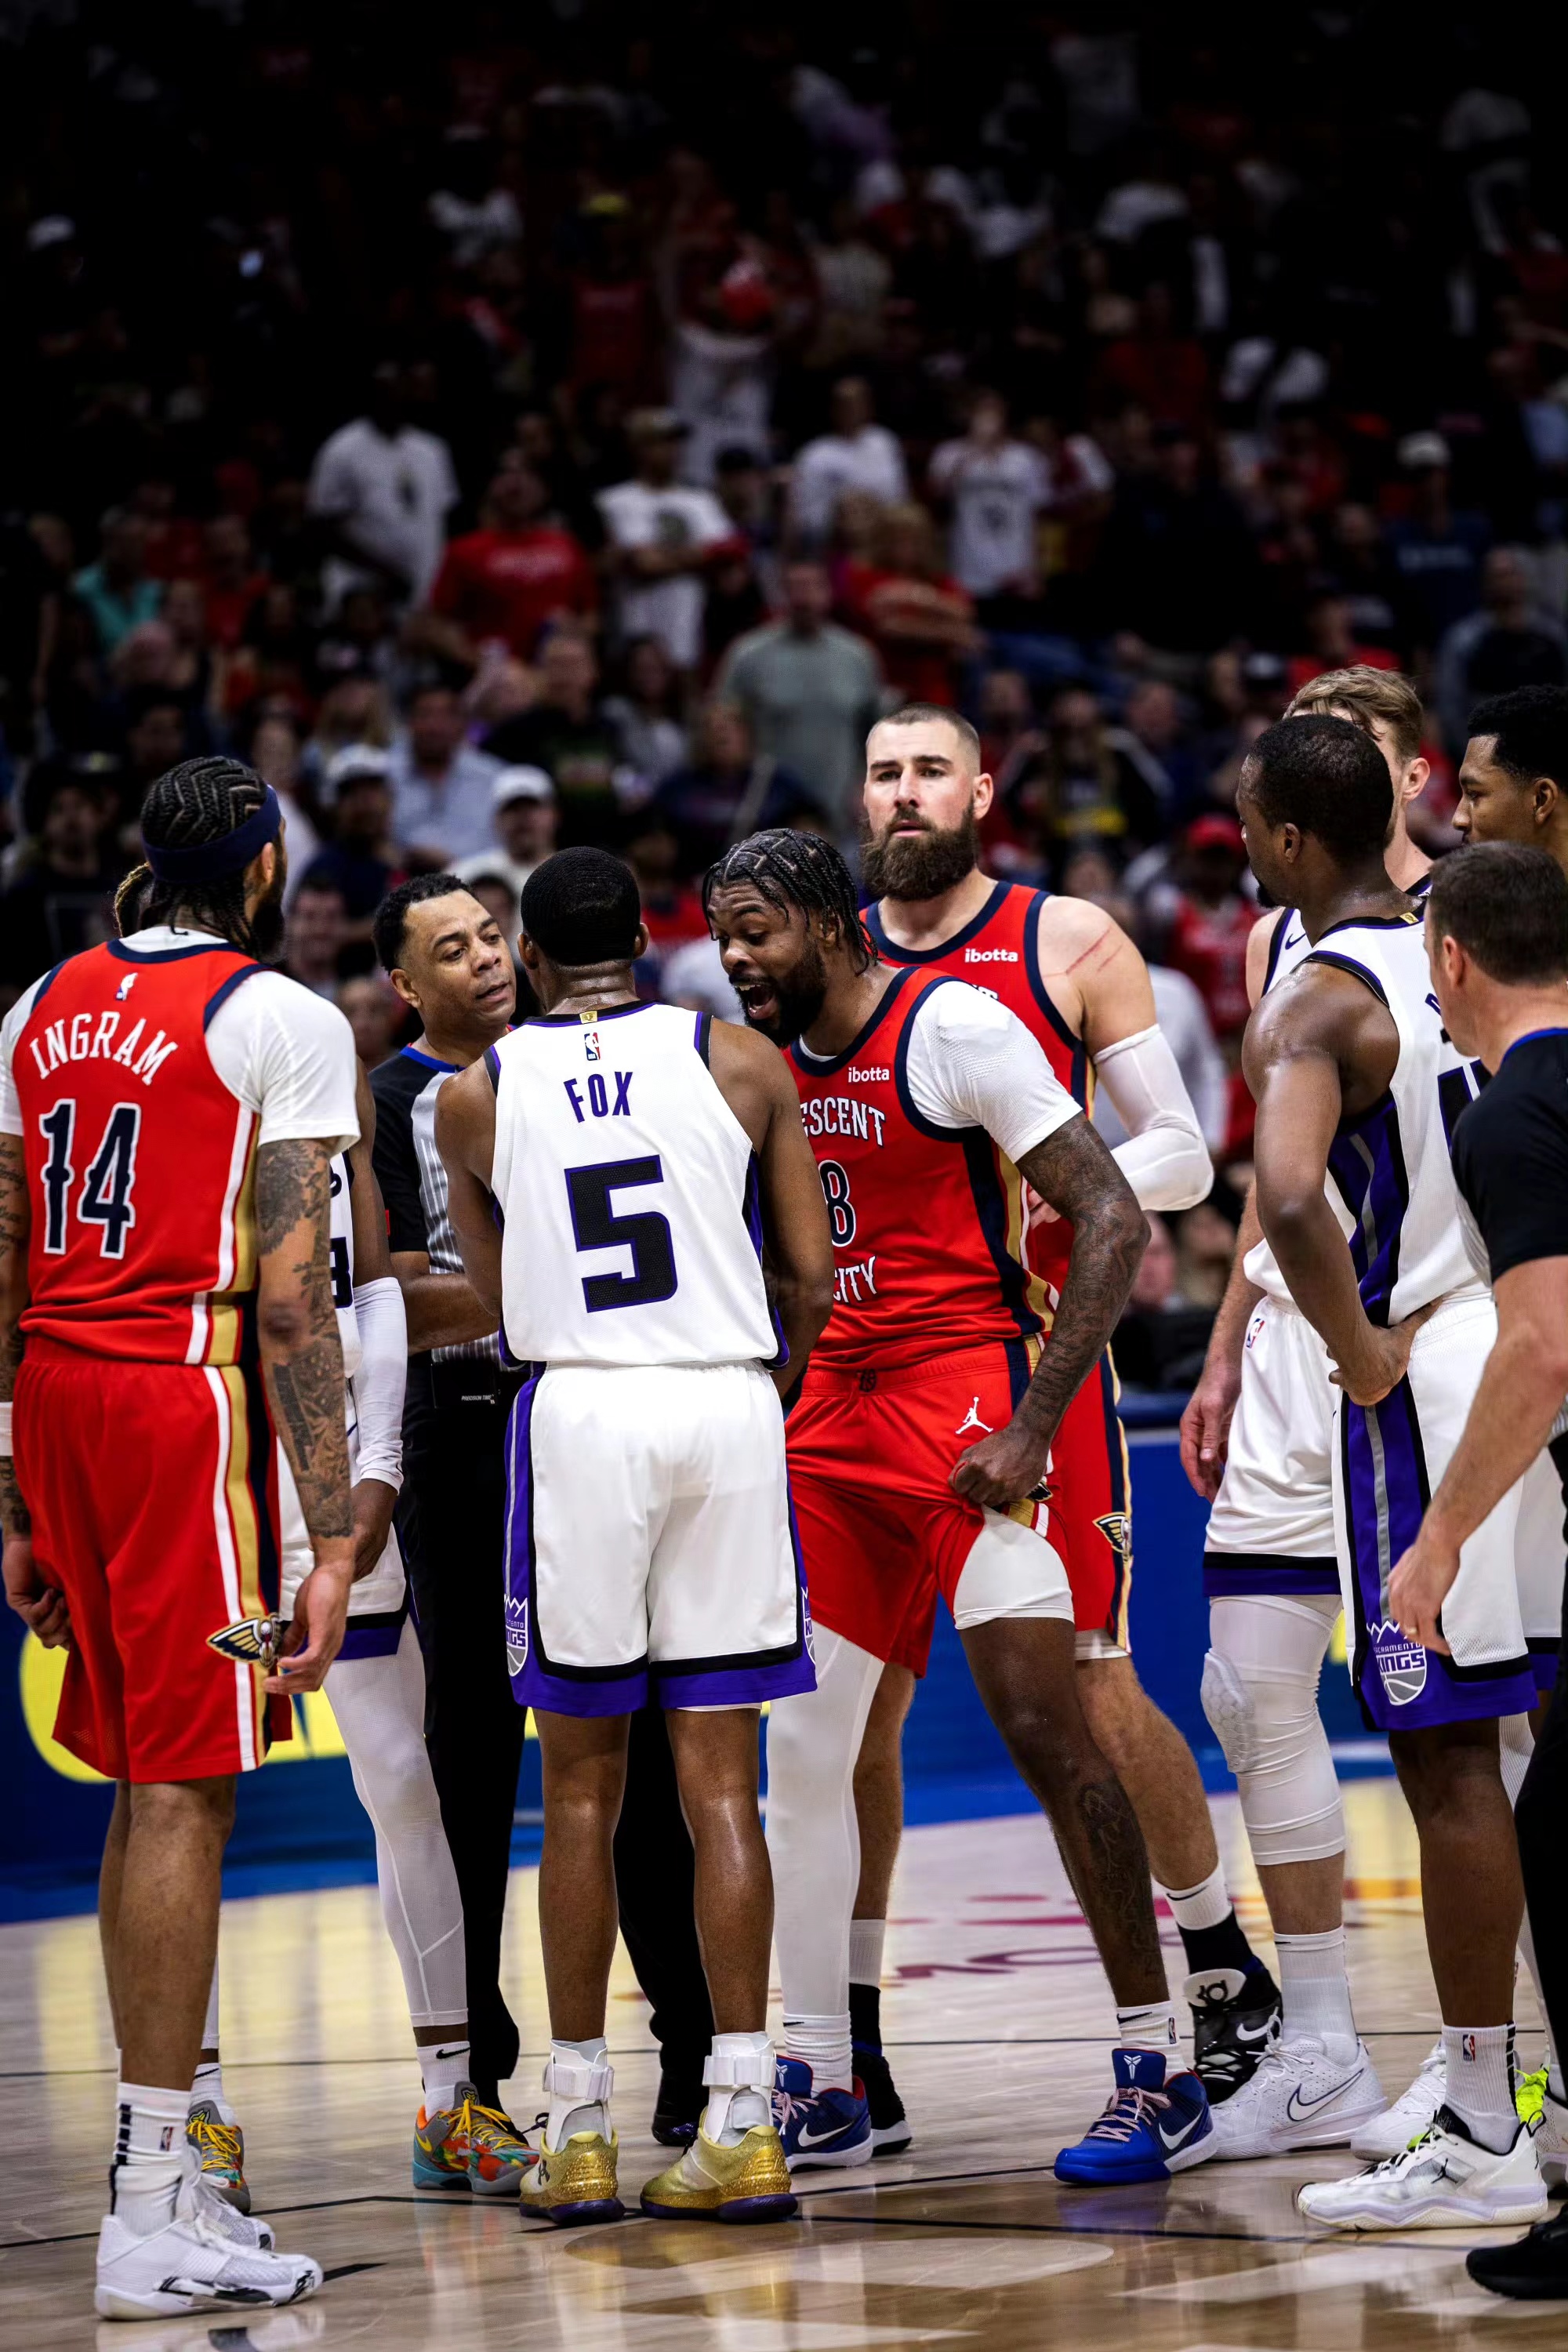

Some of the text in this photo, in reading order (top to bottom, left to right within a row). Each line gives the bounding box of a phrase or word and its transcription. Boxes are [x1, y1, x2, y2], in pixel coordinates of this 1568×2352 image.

[964, 948, 1018, 964] ibotta
[30, 1011, 179, 1087] INGRAM
[848, 1066, 891, 1083] ibotta
[563, 1071, 633, 1123] FOX
[39, 1098, 142, 1260] 14
[818, 1160, 857, 1247] 8
[563, 1154, 678, 1314] 5
